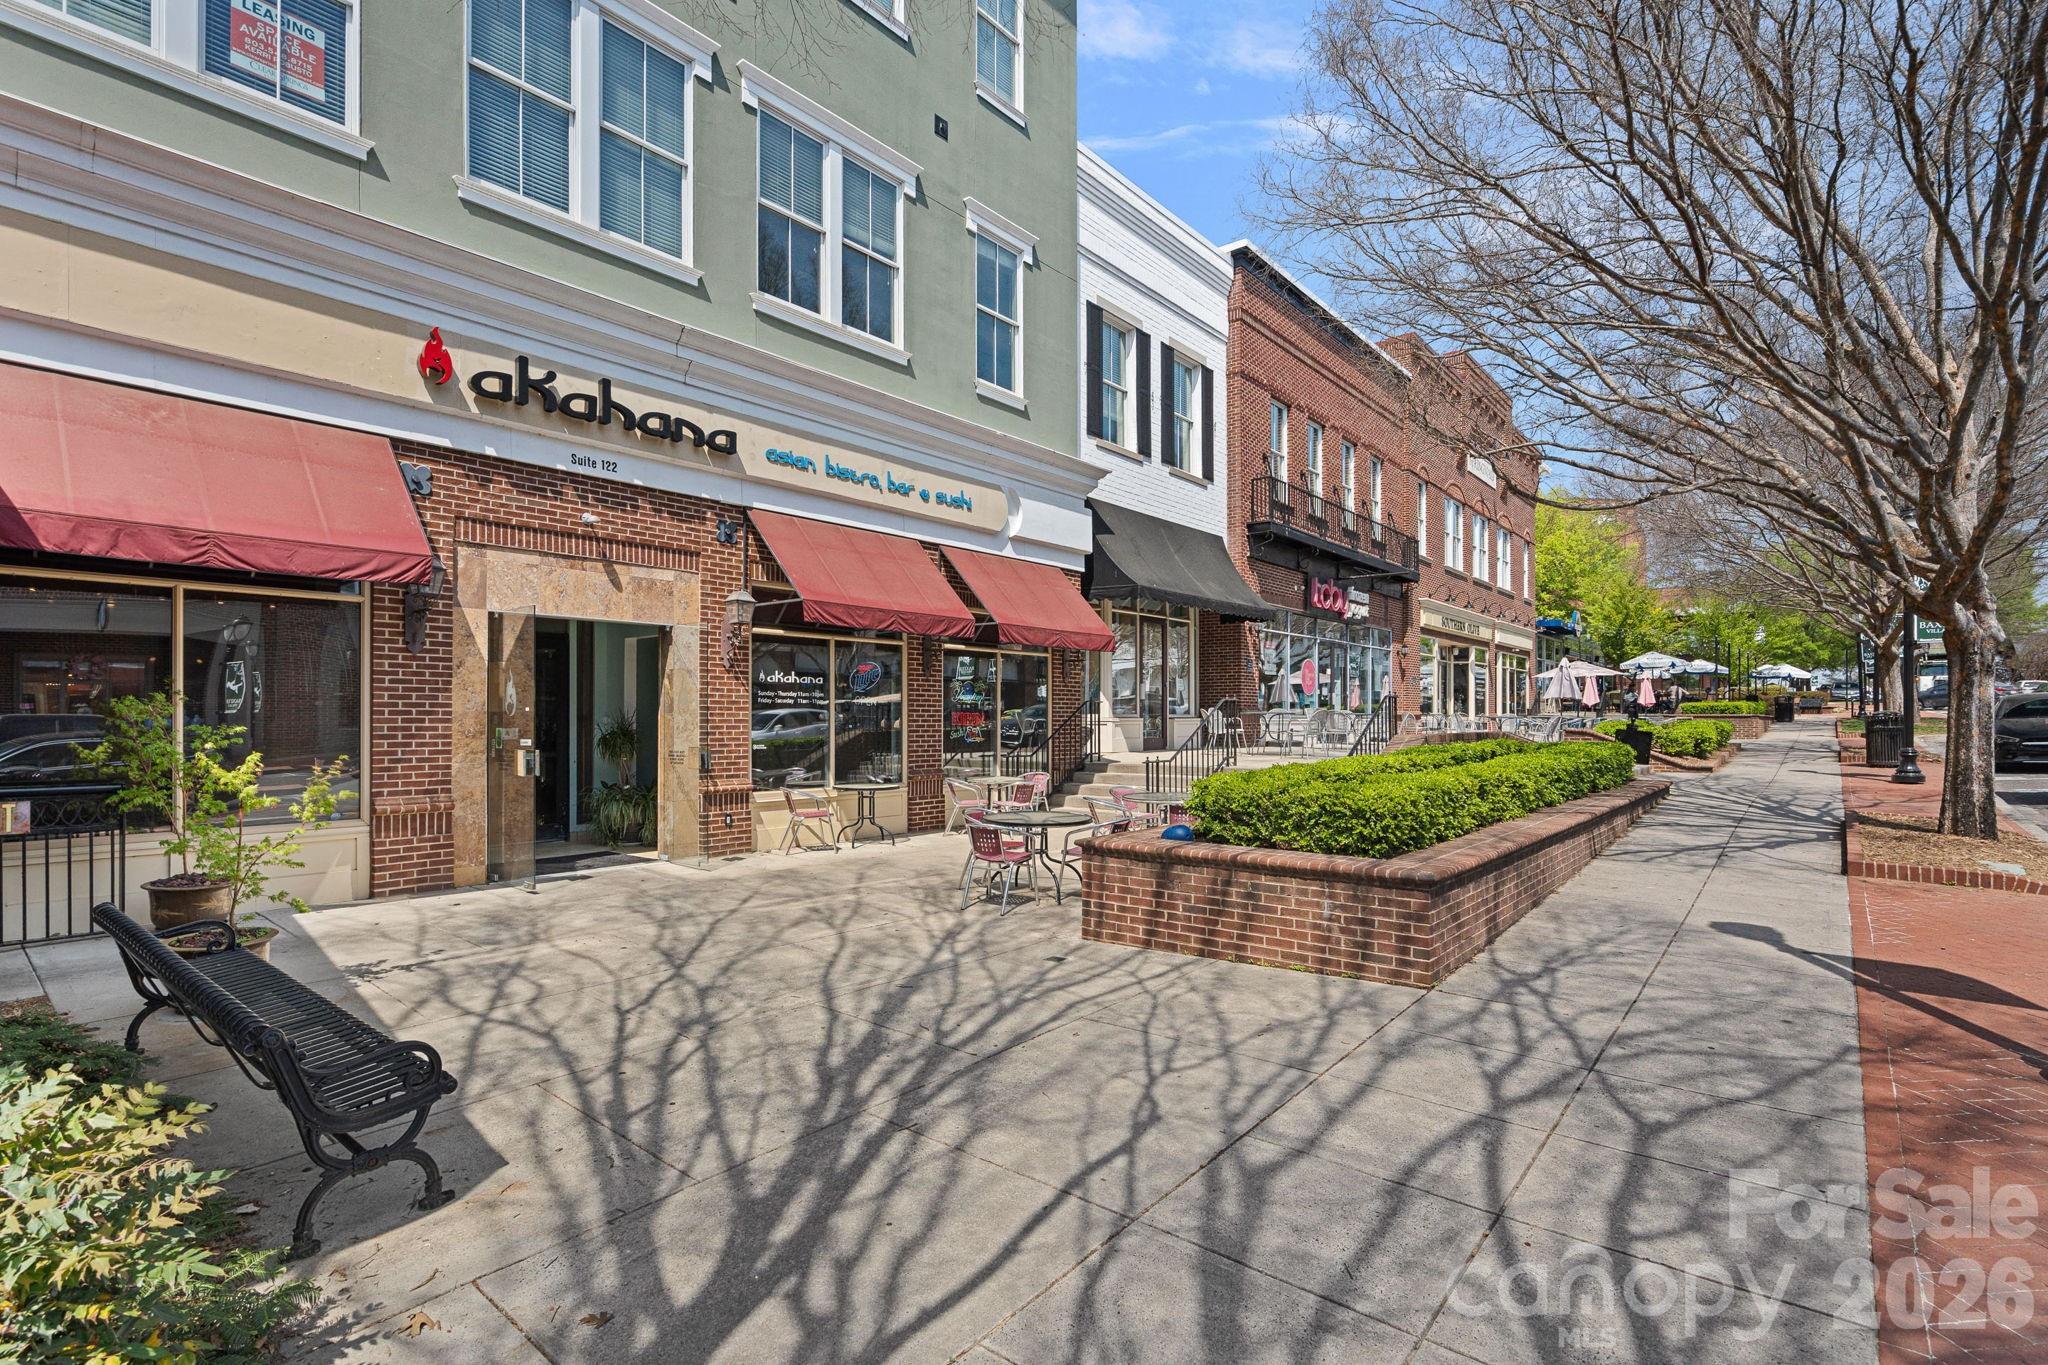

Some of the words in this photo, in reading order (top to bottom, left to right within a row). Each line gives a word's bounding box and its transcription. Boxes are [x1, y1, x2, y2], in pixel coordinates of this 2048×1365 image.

[242, 0, 315, 41] LEASING
[240, 24, 317, 64] AVAILABLE
[244, 43, 271, 60] KERRI
[570, 453, 597, 469] Suite
[601, 460, 618, 473] 122
[765, 448, 816, 474] asian
[887, 471, 915, 497] bar
[935, 489, 973, 512] sushi
[1441, 616, 1466, 634] SOUTHERN
[1466, 622, 1480, 636] OLIVE
[778, 690, 798, 698] Thursday
